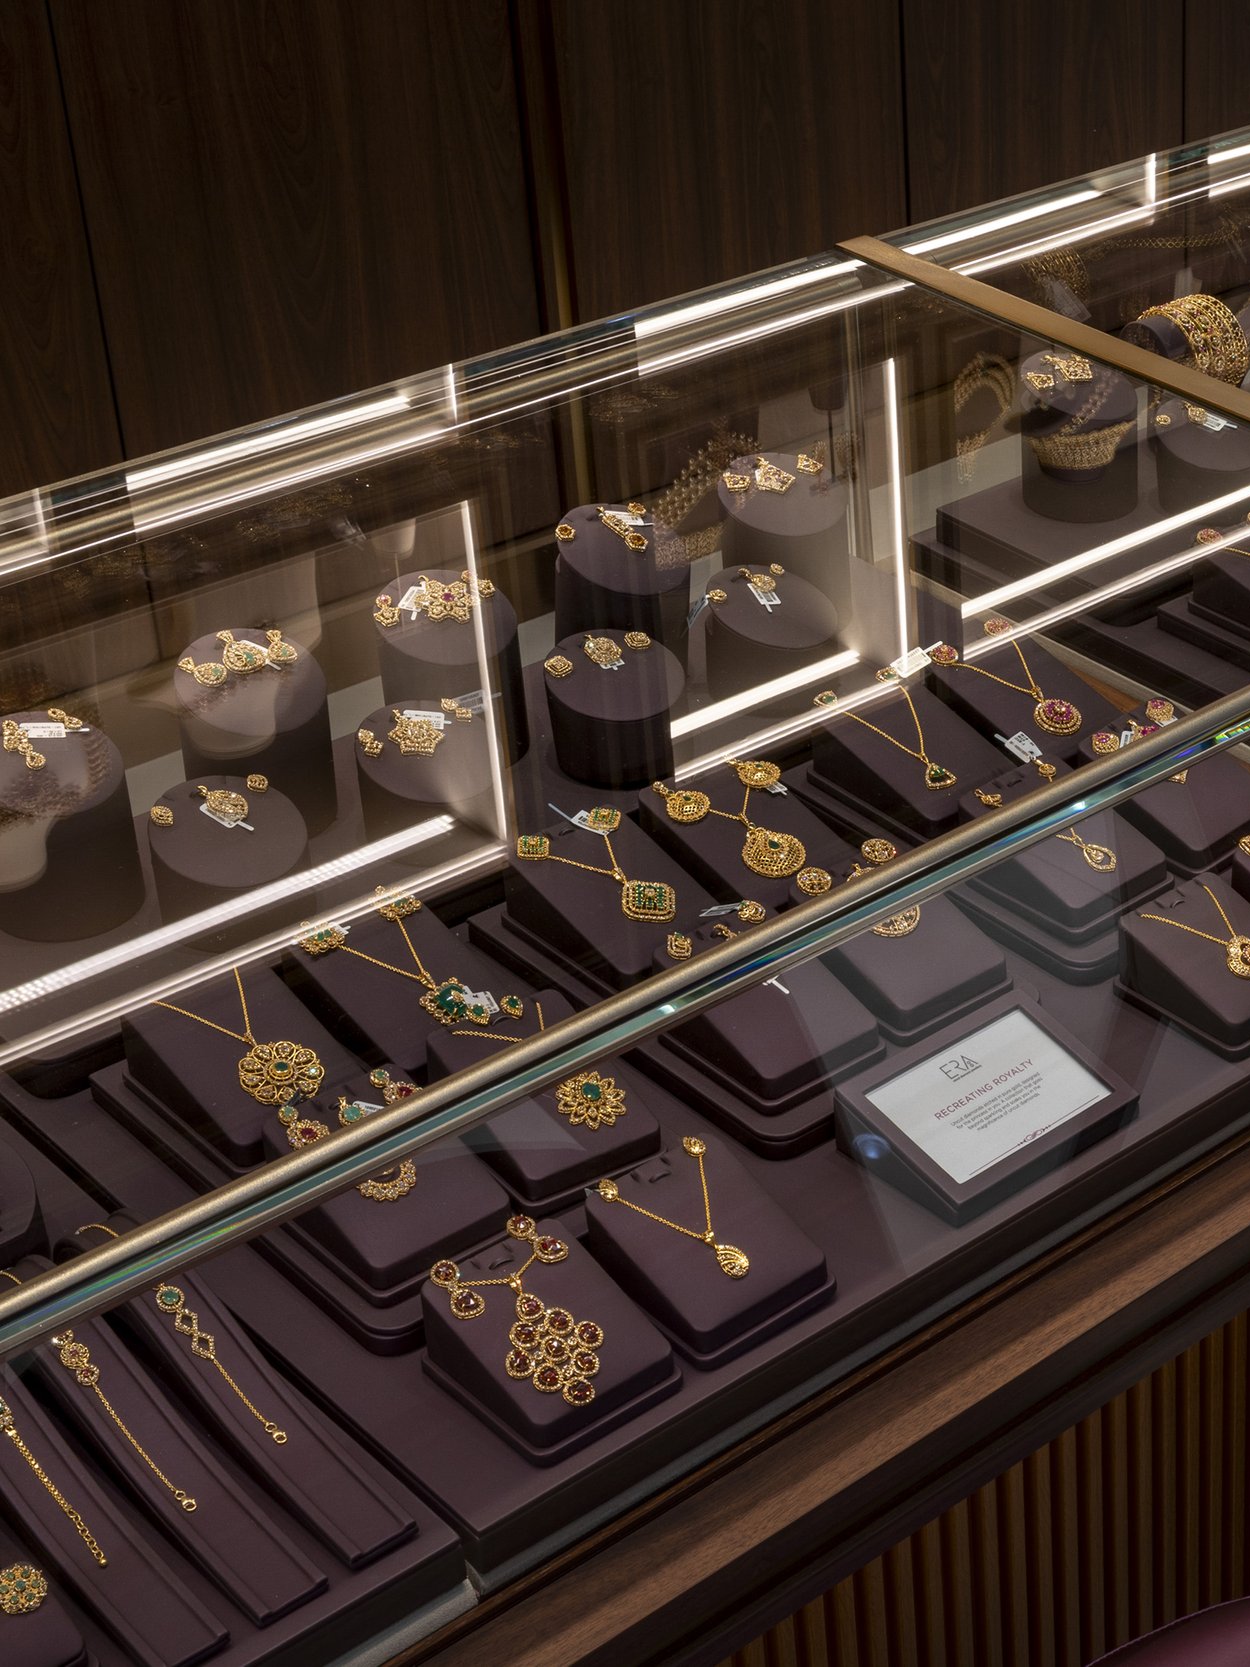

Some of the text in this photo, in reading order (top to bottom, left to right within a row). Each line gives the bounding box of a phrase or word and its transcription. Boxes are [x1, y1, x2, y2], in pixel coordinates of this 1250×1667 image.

[939, 1055, 978, 1080] ERA
[934, 1083, 993, 1120] RECREATING
[992, 1059, 1033, 1086] ROYALTY
